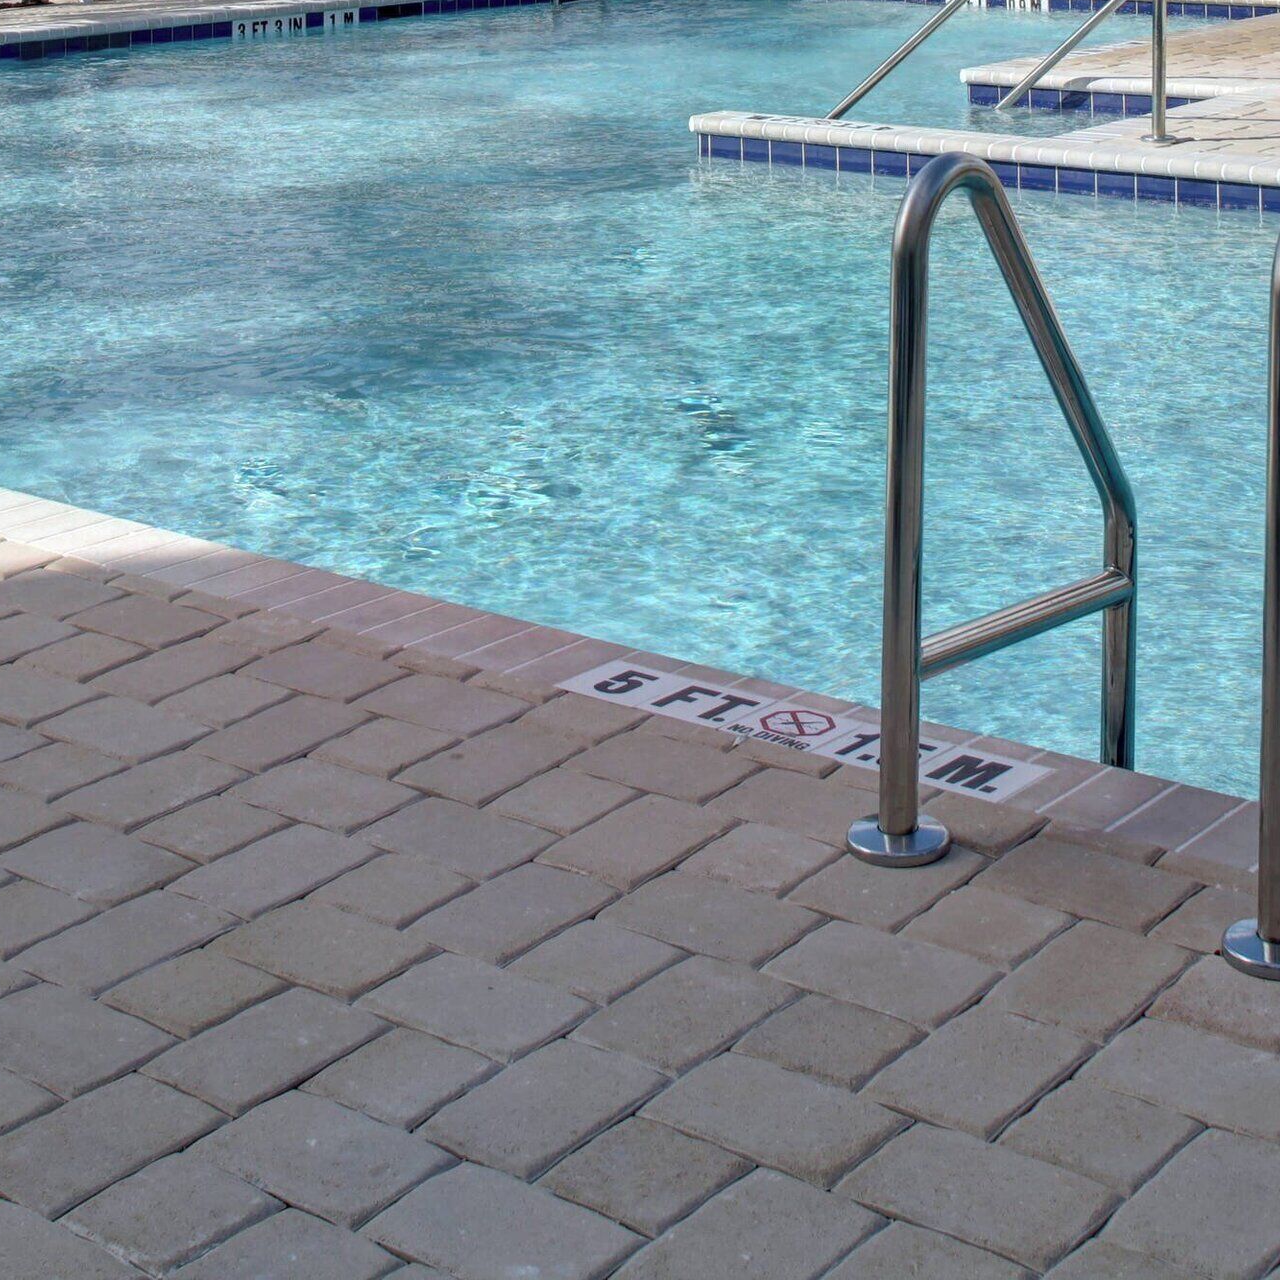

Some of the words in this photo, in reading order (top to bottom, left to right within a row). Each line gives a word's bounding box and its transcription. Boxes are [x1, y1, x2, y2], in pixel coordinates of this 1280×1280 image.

[252, 20, 268, 33] FT
[289, 17, 303, 30] IN
[344, 12, 354, 24] M
[593, 670, 659, 694] 5
[651, 685, 761, 722] FT.
[925, 754, 1014, 794] M.
[727, 723, 754, 735] NO
[753, 730, 811, 752] DIVING
